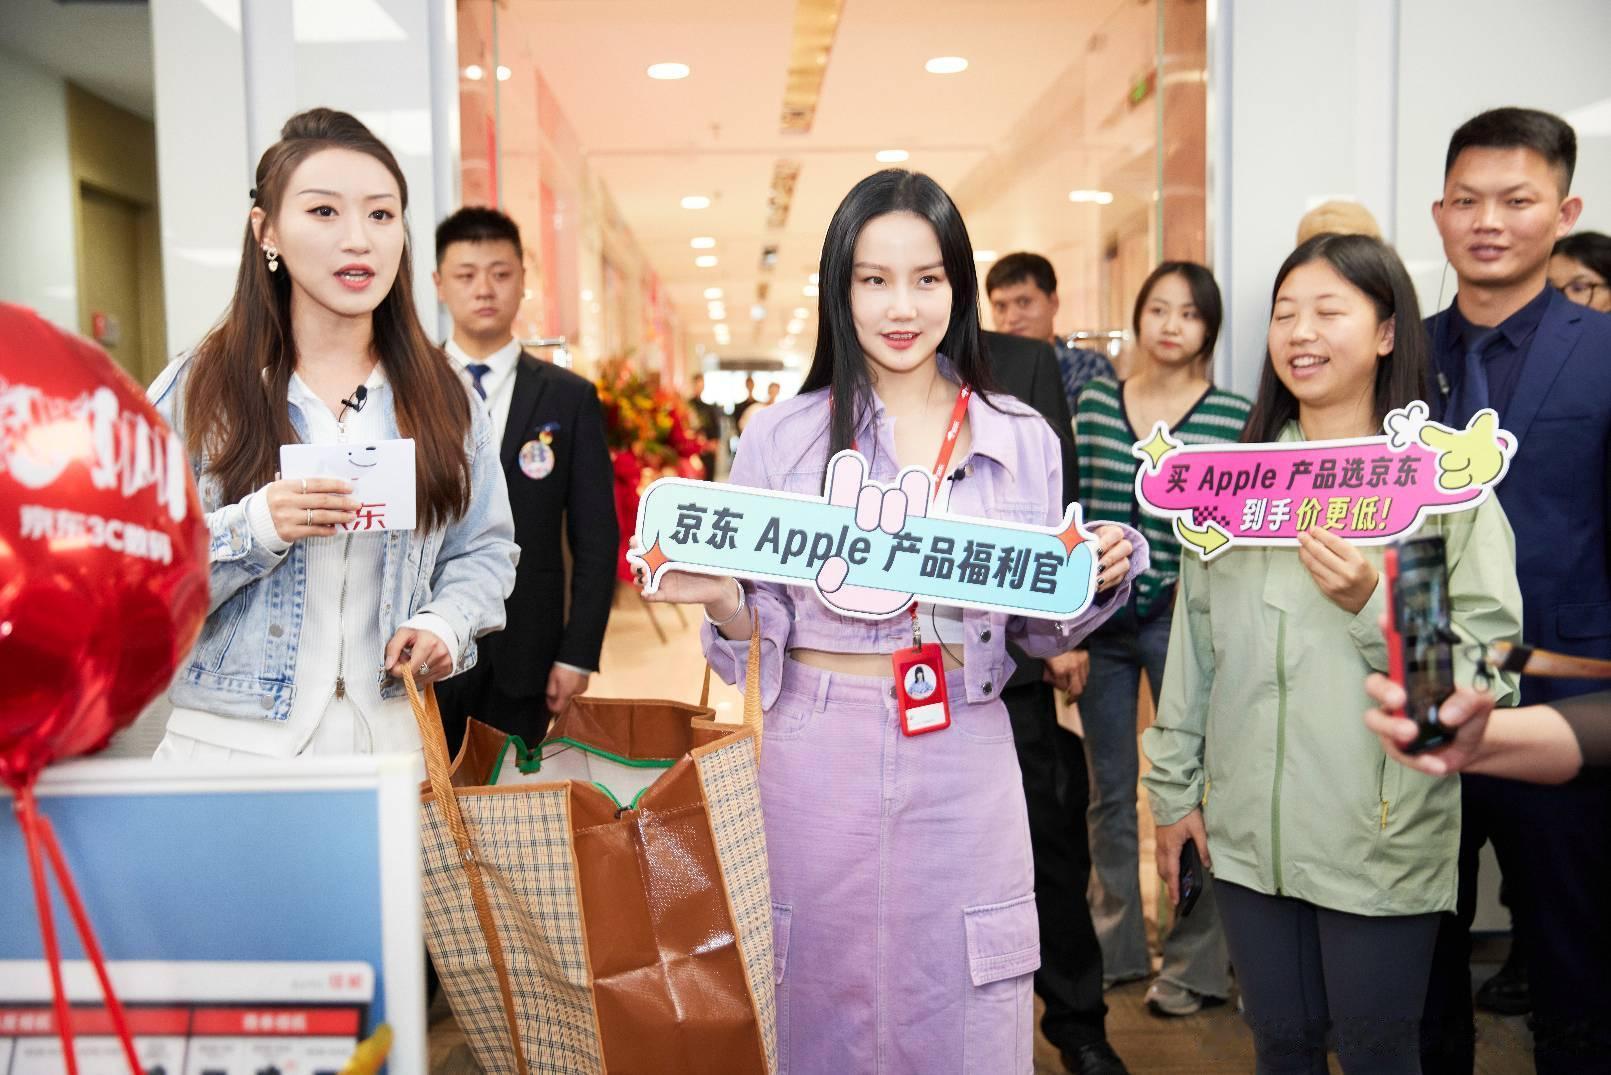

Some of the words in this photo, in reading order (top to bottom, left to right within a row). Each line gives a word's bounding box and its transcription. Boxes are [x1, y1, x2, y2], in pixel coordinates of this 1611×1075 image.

[1165, 463, 1190, 494] 买
[1198, 462, 1277, 497] Apple
[1286, 456, 1422, 491] 产品选京东
[1239, 497, 1392, 532] 到手价更低!
[669, 502, 744, 550] 京东
[755, 516, 872, 568] Apple
[882, 532, 1064, 594] 产品福利官
